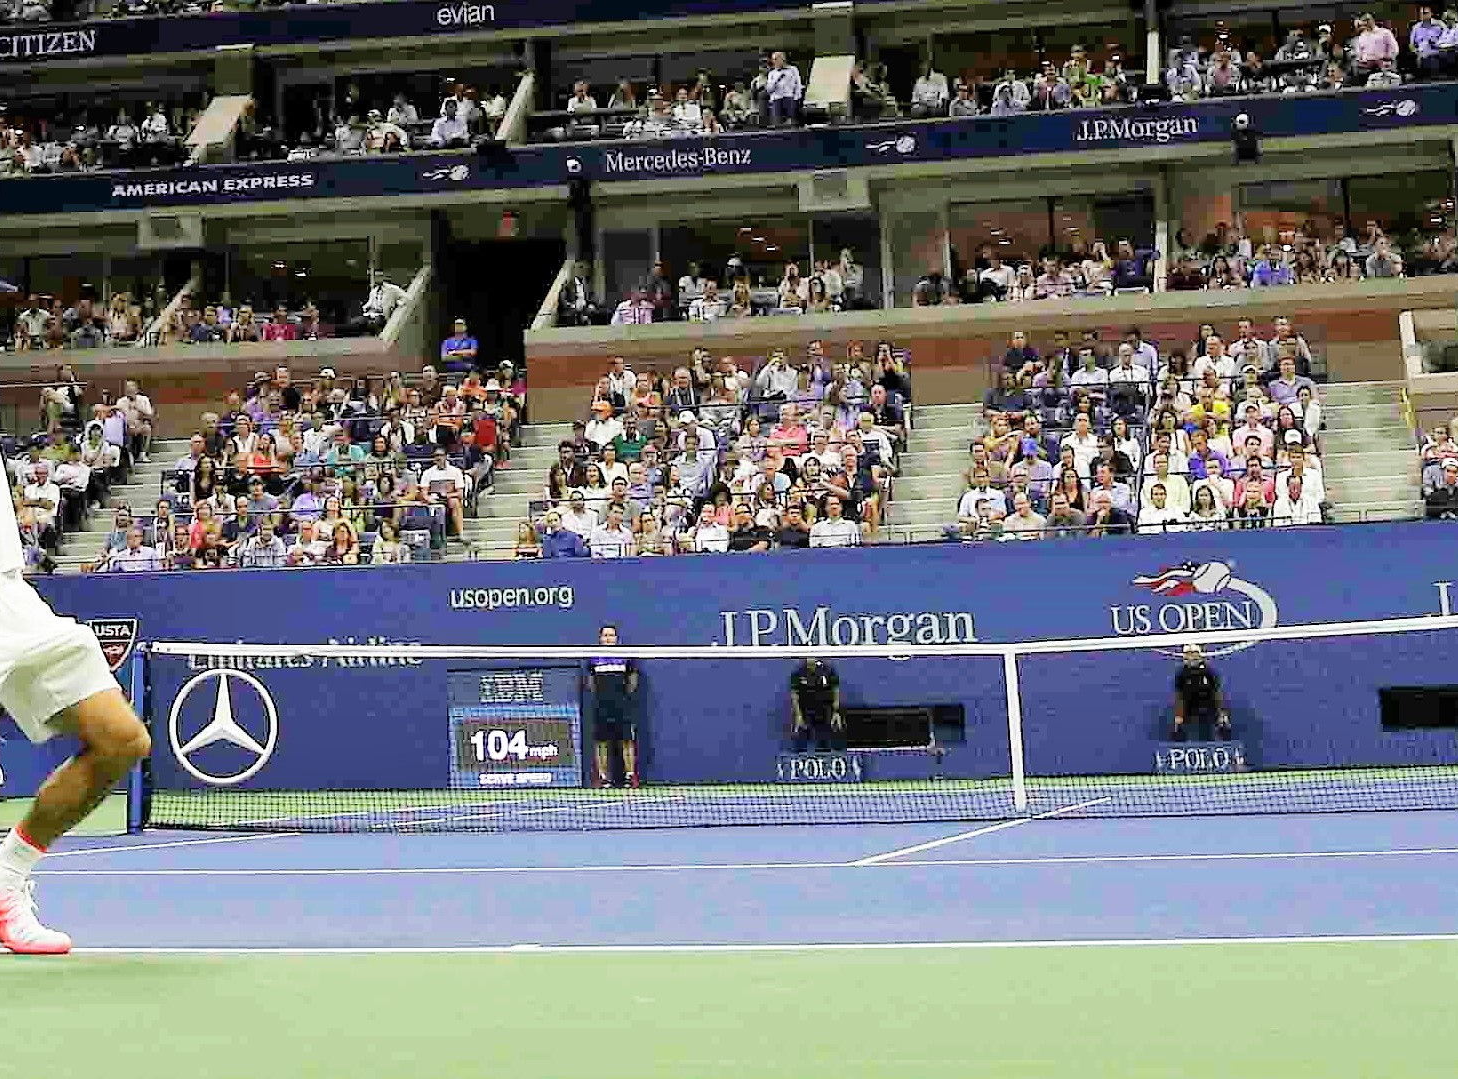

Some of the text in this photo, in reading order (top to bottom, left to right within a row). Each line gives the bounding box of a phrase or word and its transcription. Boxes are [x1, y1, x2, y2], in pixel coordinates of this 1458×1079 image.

[437, 0, 495, 27] evian
[604, 146, 753, 175] Mercedes-Benz
[111, 172, 315, 199] AMERICAN EXPRESS
[450, 583, 574, 611] usopen.org
[94, 623, 133, 638] USTA
[1110, 600, 1255, 635] US OPEN
[470, 728, 559, 761] 104 mph
